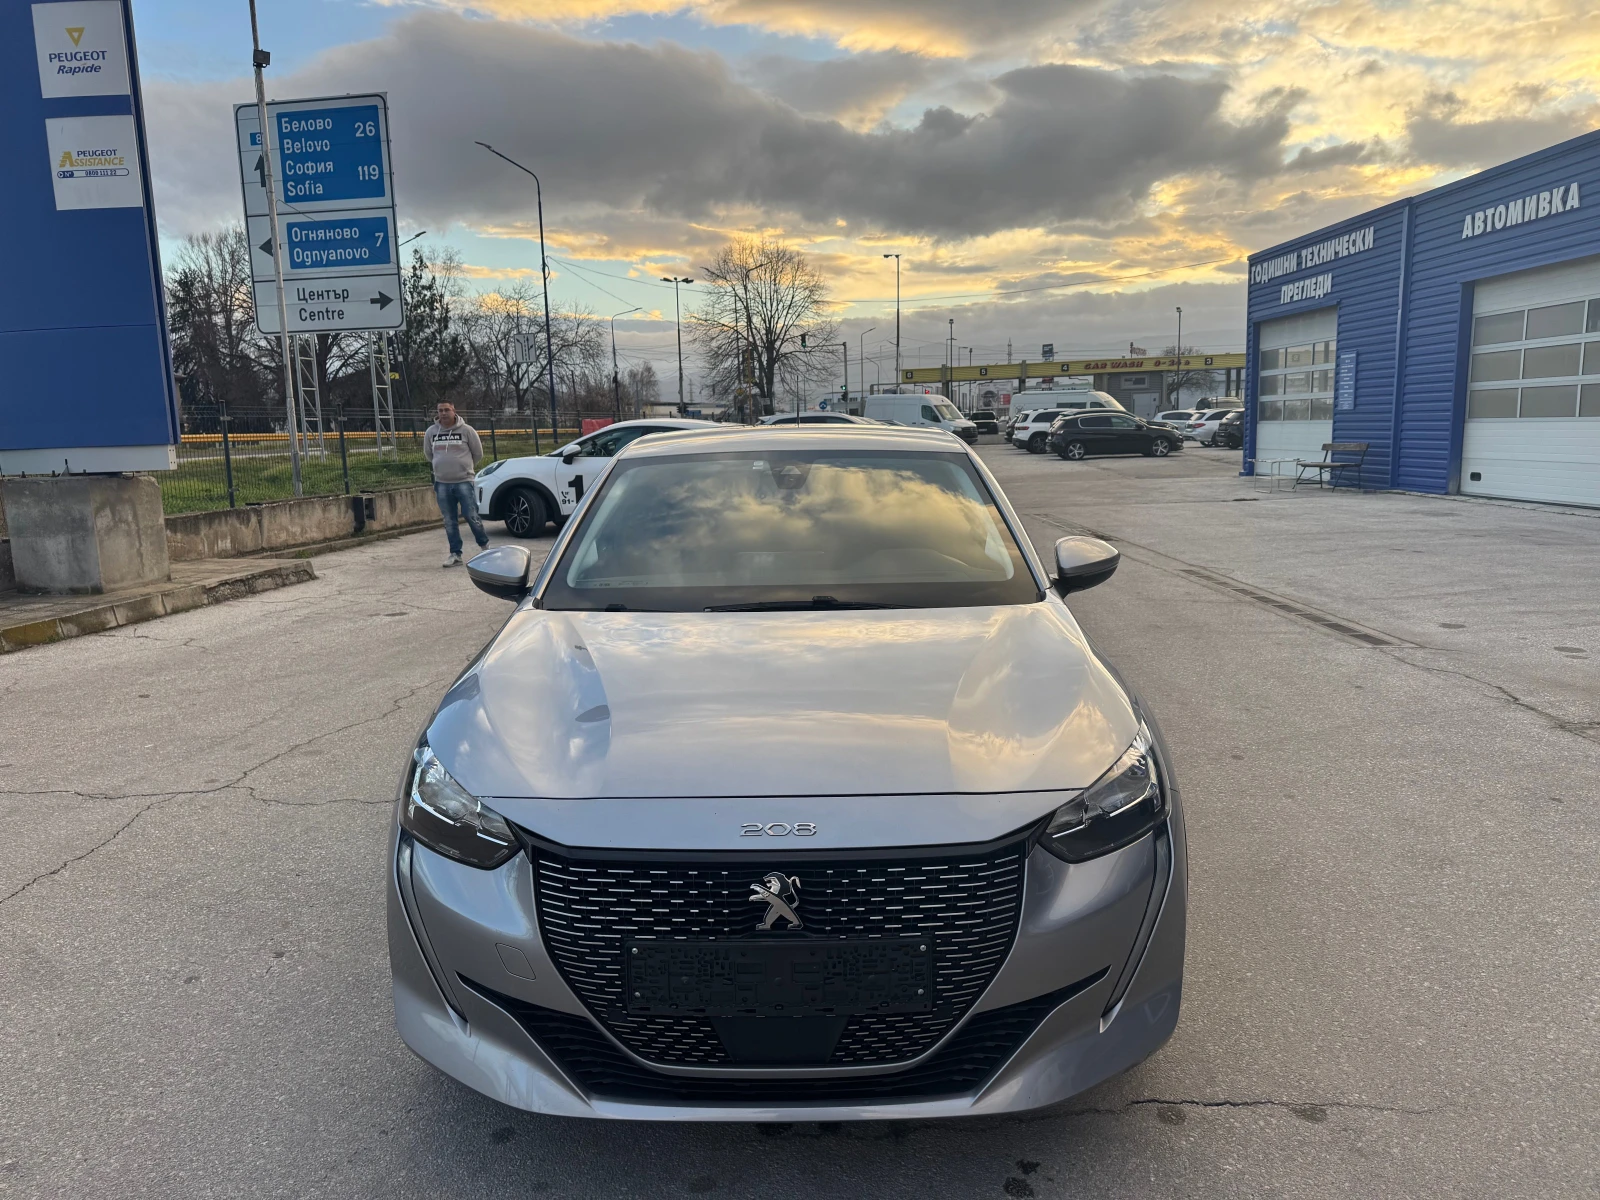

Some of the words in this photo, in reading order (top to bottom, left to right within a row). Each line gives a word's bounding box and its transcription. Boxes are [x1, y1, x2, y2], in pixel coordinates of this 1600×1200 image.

[49, 50, 107, 62] PEUGEOT
[57, 63, 101, 75] Rapide
[281, 118, 333, 133] Белово
[354, 121, 376, 137] 26
[77, 149, 118, 157] PEUGEOT
[283, 138, 331, 154] Belovo
[59, 151, 124, 167] ASSISTANCE
[285, 160, 334, 175] София
[357, 165, 379, 181] 119
[286, 181, 324, 197] Sofia
[1462, 182, 1581, 239] АВТОМИВКА
[291, 227, 360, 242] Огняново
[375, 232, 384, 247] 7
[293, 246, 370, 266] Ognyanovo
[1250, 252, 1298, 285] ГОДИШНИ
[1301, 226, 1375, 268] ТЕХНИЧЕСКИ
[296, 287, 350, 304] Център
[1280, 272, 1333, 304] ПРЕГЛЕДИ
[298, 306, 345, 322] Centre
[1084, 362, 1107, 371] CAR
[1110, 360, 1144, 370] WASH
[740, 822, 817, 836] 208
